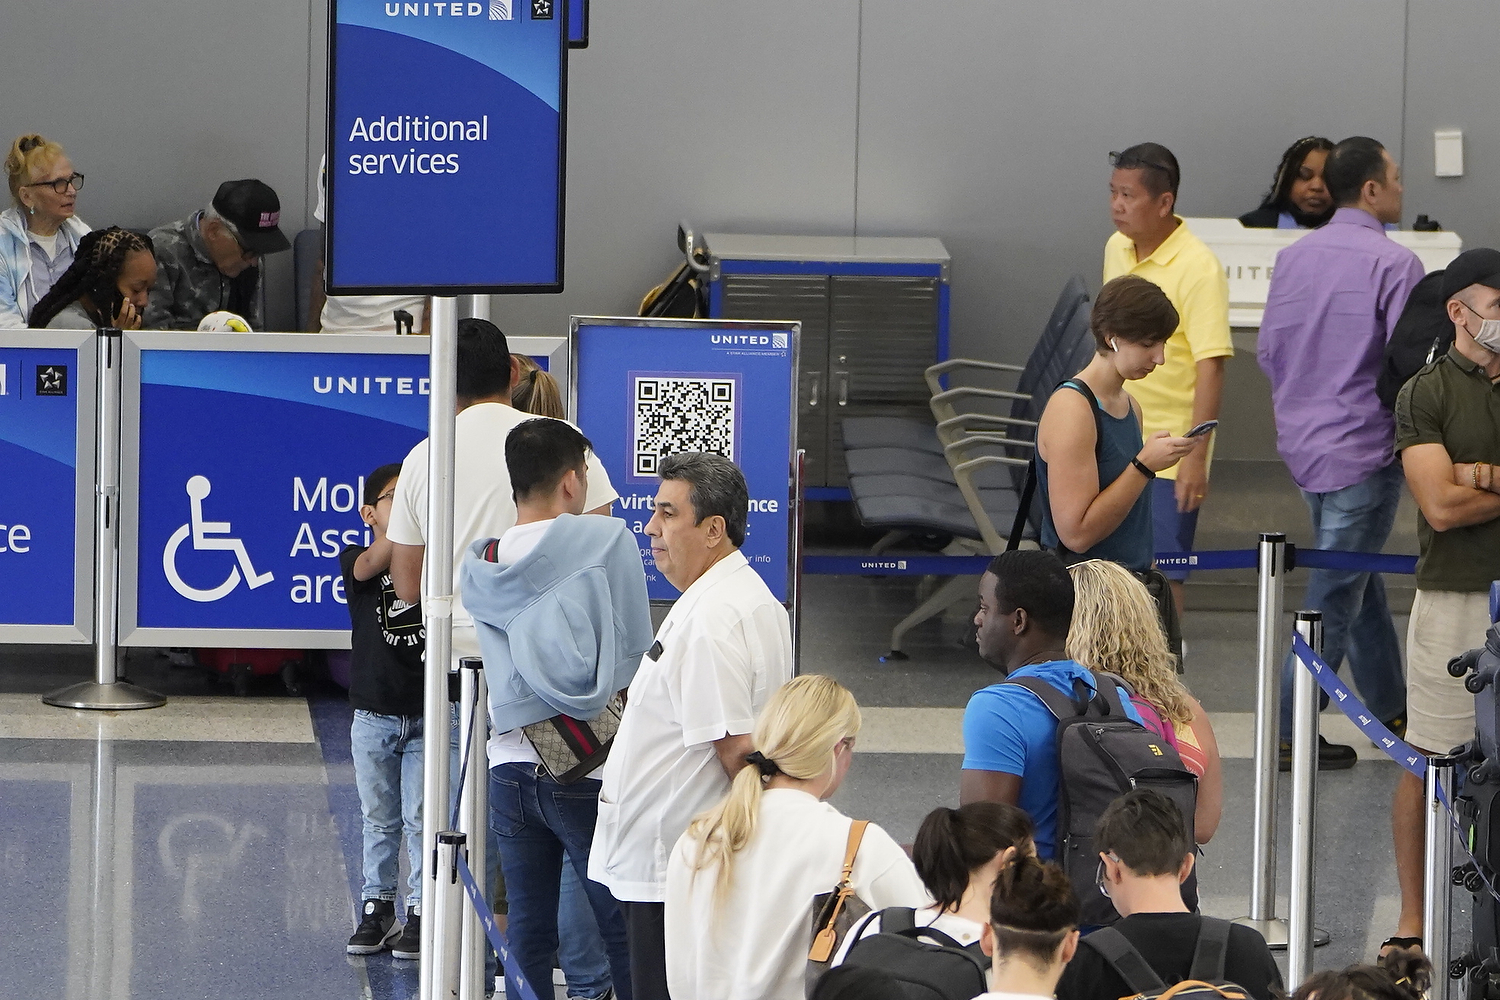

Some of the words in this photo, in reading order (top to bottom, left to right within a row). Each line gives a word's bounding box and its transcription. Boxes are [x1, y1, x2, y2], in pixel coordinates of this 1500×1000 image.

[385, 3, 483, 16] UNITED
[349, 115, 488, 142] Additional
[349, 148, 460, 174] services
[711, 334, 769, 345] UNITED
[313, 376, 430, 395] UNITED
[755, 554, 771, 563] info
